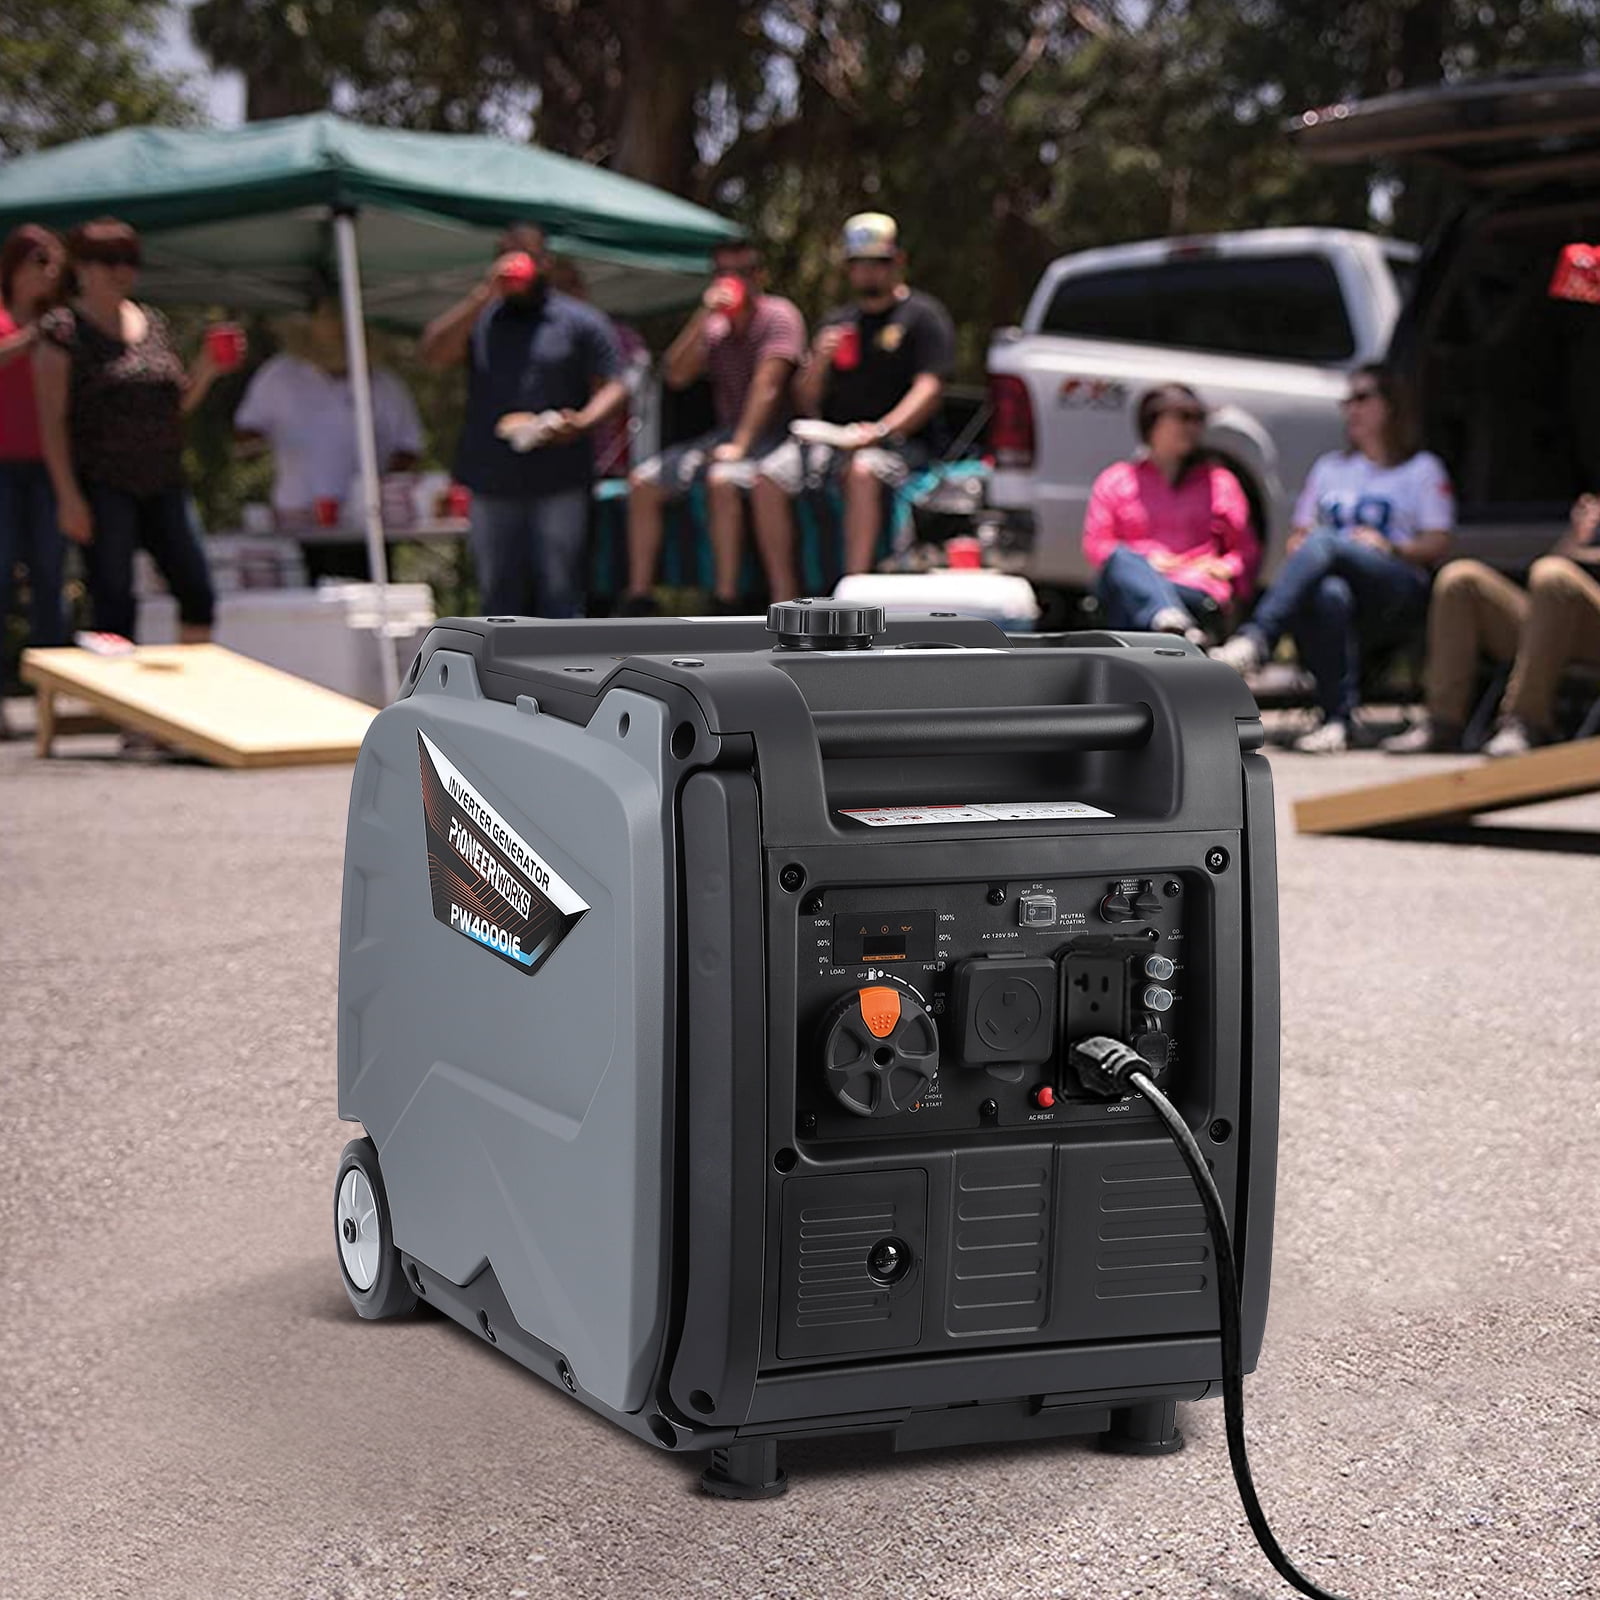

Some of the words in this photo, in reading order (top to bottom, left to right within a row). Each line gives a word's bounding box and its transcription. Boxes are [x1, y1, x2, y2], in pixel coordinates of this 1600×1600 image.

[448, 776, 492, 832] INVERTER
[493, 824, 550, 891] GENERATOR
[938, 934, 952, 942] 50%
